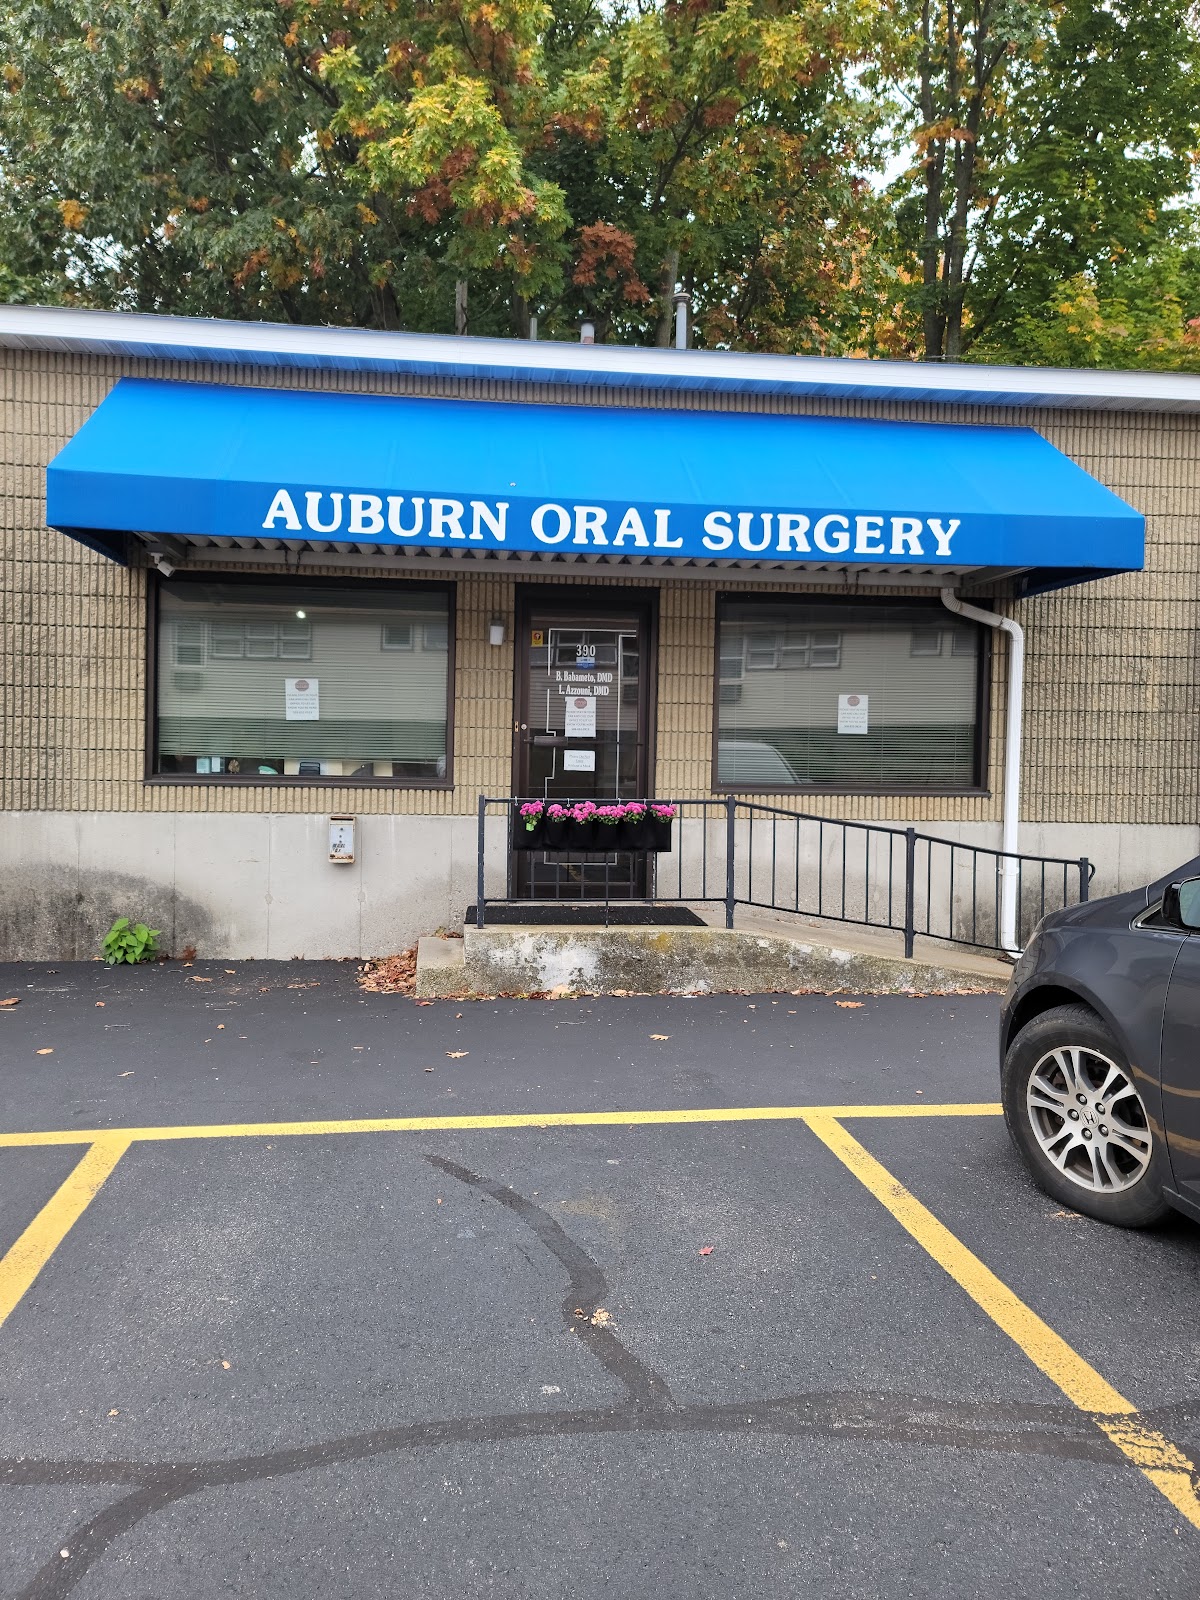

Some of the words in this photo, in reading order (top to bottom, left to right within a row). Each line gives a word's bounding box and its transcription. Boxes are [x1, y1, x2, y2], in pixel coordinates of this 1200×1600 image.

[262, 489, 509, 541] AUBURN
[530, 503, 683, 549] ORAL
[701, 511, 960, 557] SURGERY
[576, 644, 596, 656] 390
[555, 670, 563, 682] B.
[597, 672, 613, 683] DMD
[558, 684, 566, 695] L.
[593, 685, 609, 696] DMD
